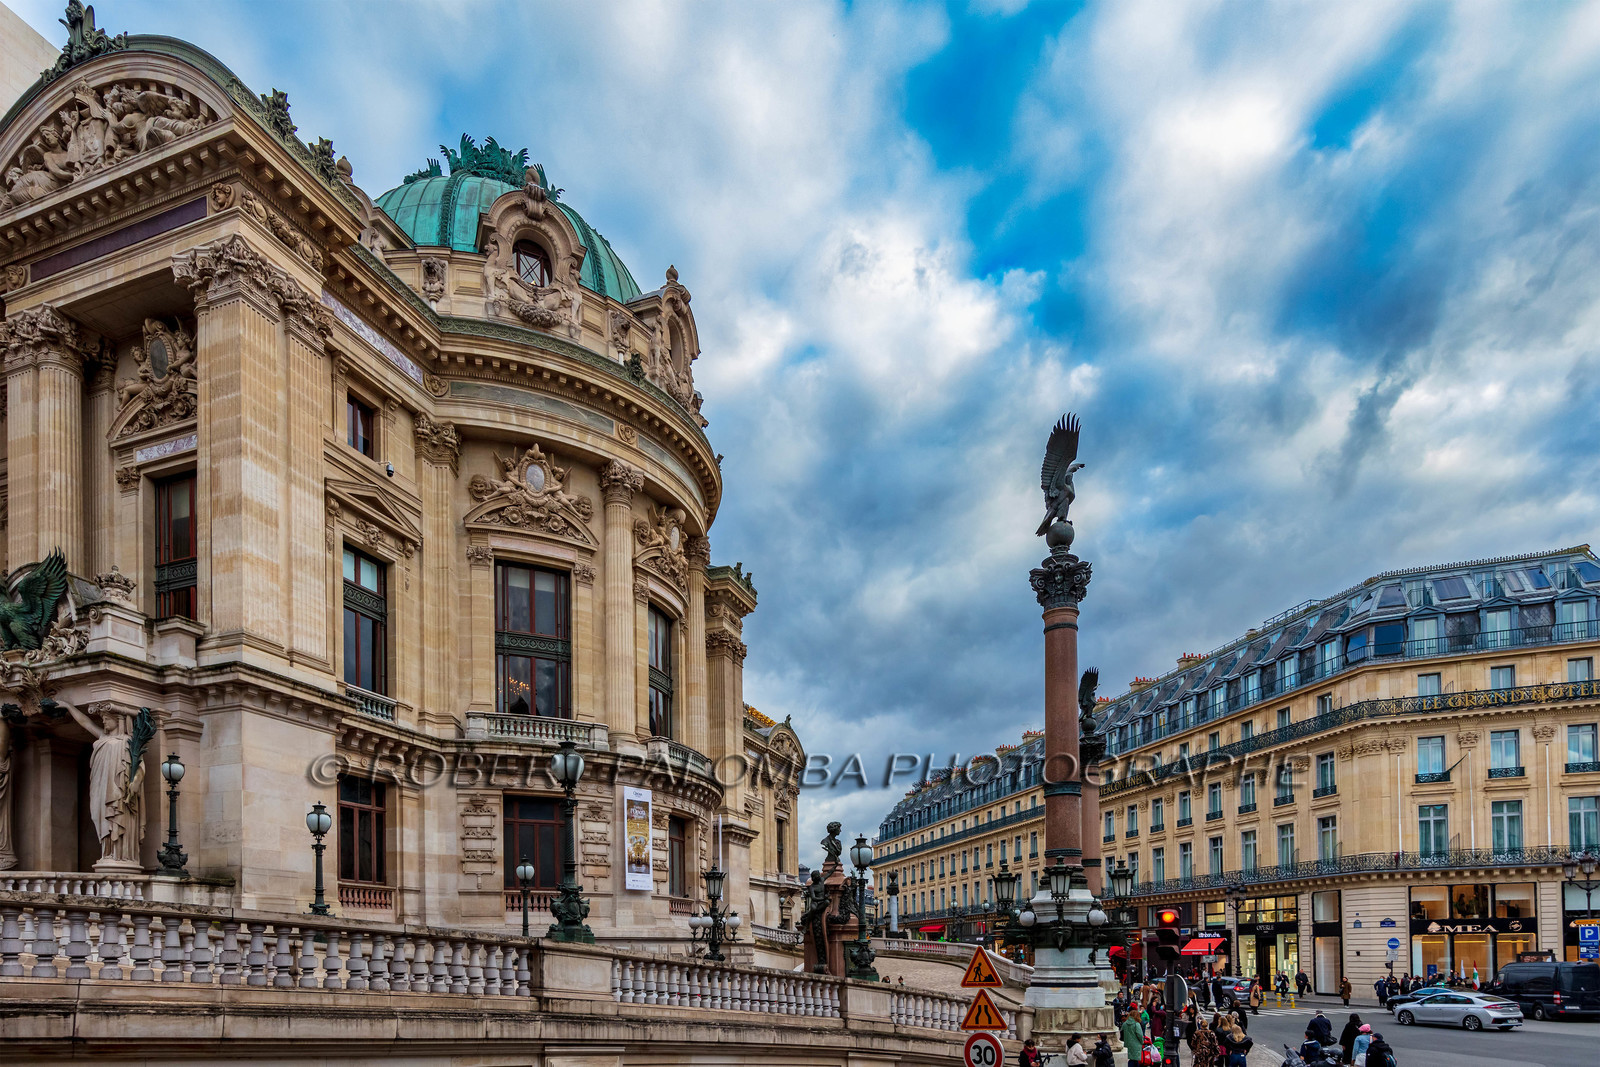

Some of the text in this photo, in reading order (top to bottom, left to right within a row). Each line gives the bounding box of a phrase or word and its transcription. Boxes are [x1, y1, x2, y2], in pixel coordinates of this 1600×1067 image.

[1423, 698, 1441, 710] LE
[1448, 690, 1524, 708] GRAND
[1442, 924, 1499, 932] MEA
[1585, 928, 1594, 938] P
[972, 1044, 995, 1065] 30
